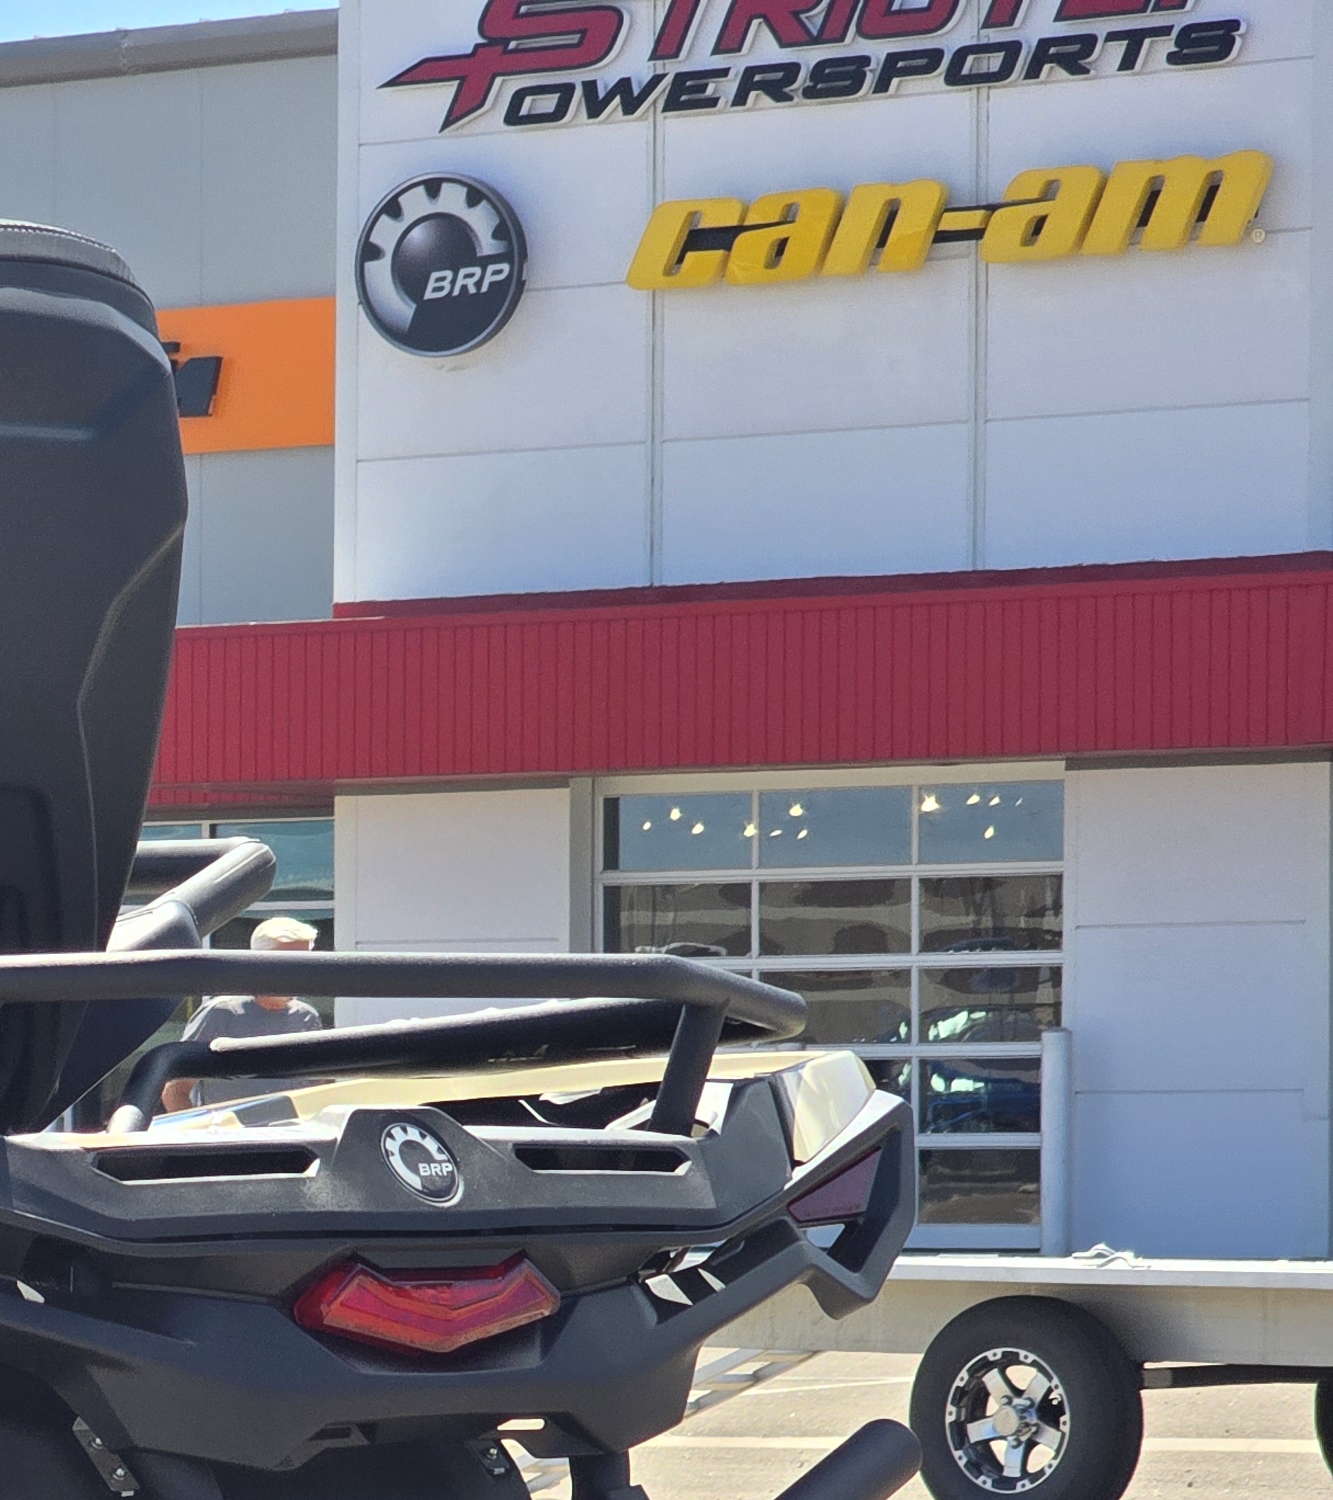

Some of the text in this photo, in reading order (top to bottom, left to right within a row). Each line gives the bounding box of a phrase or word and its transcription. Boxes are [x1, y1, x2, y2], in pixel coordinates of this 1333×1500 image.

[626, 149, 1274, 290] can-am
[423, 262, 511, 301] BRP
[418, 1163, 453, 1176] BRP
